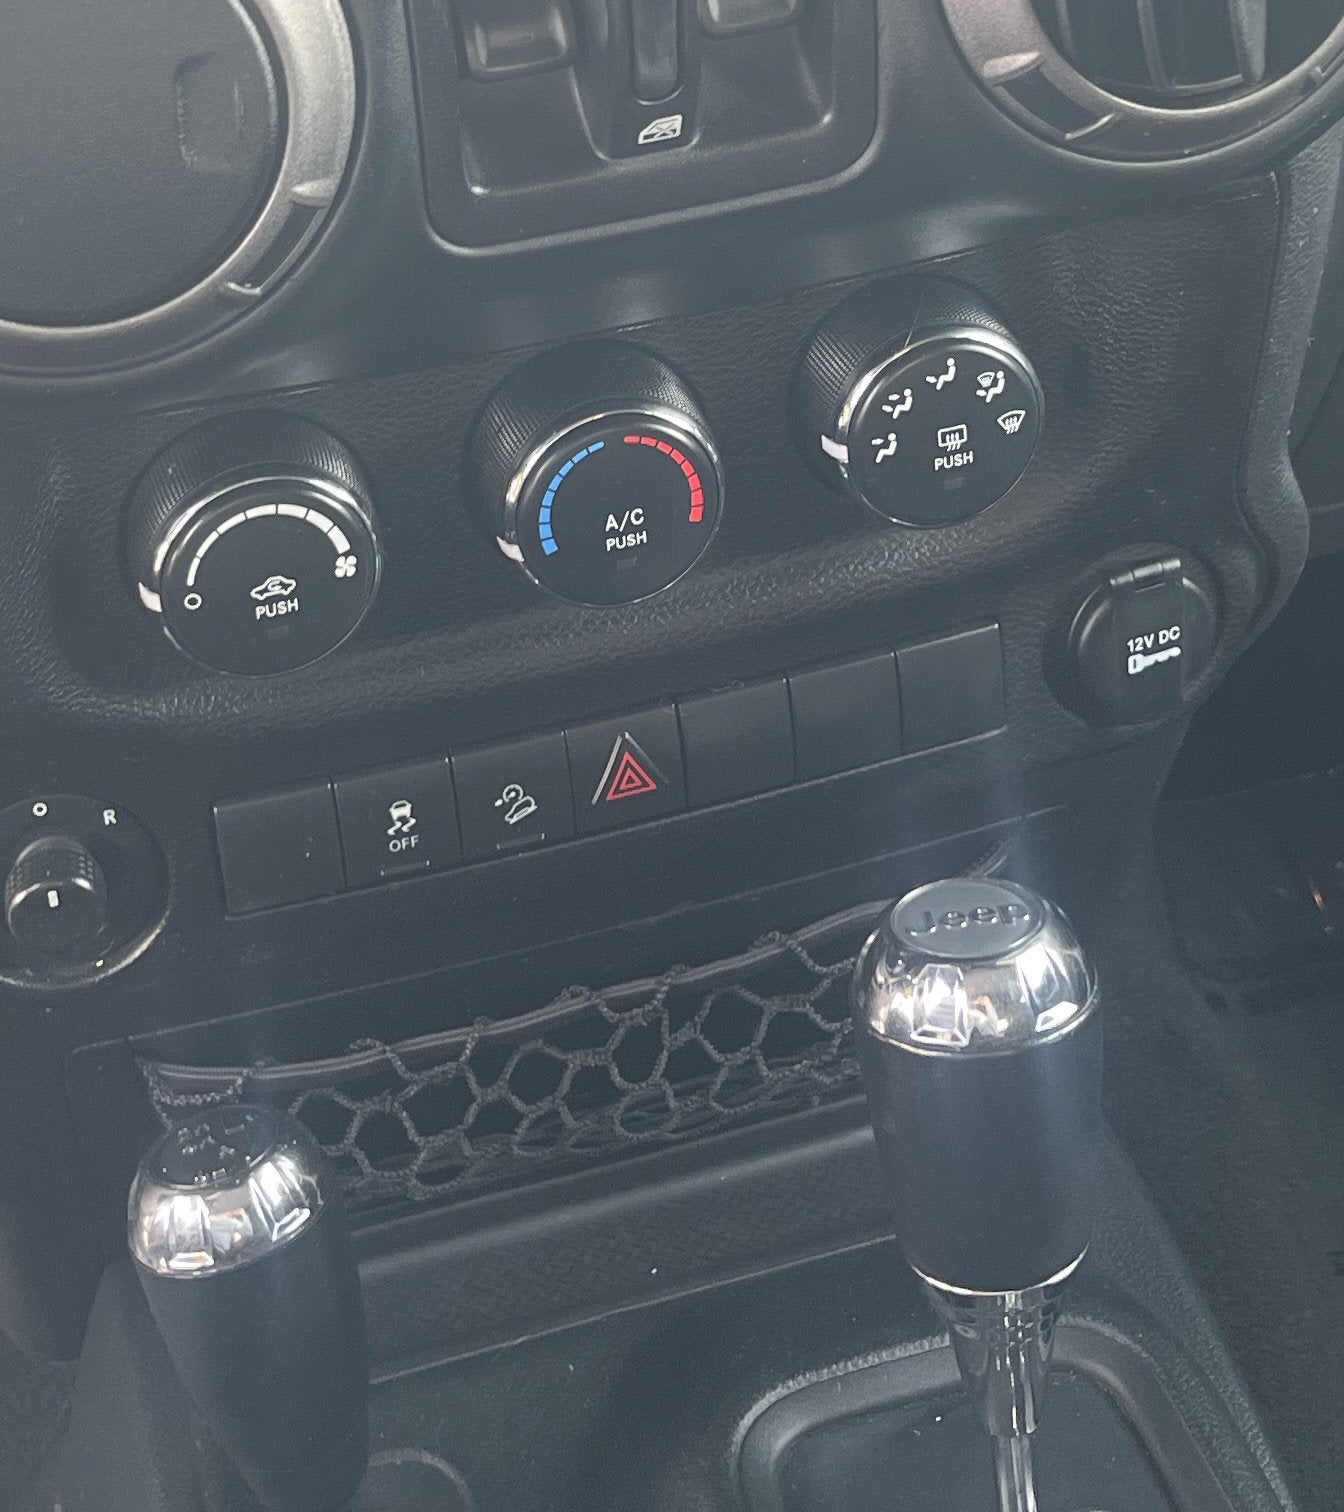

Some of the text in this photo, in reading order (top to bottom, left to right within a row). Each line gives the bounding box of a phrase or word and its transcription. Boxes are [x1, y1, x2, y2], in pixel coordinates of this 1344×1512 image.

[934, 451, 974, 471] PUSH
[605, 507, 645, 532] A/C
[605, 530, 647, 551] PUSH
[255, 597, 298, 619] PUSH
[1127, 625, 1181, 653] 12V DC
[103, 810, 116, 825] R
[388, 834, 419, 853] OFF
[908, 904, 1031, 938] Jeep
